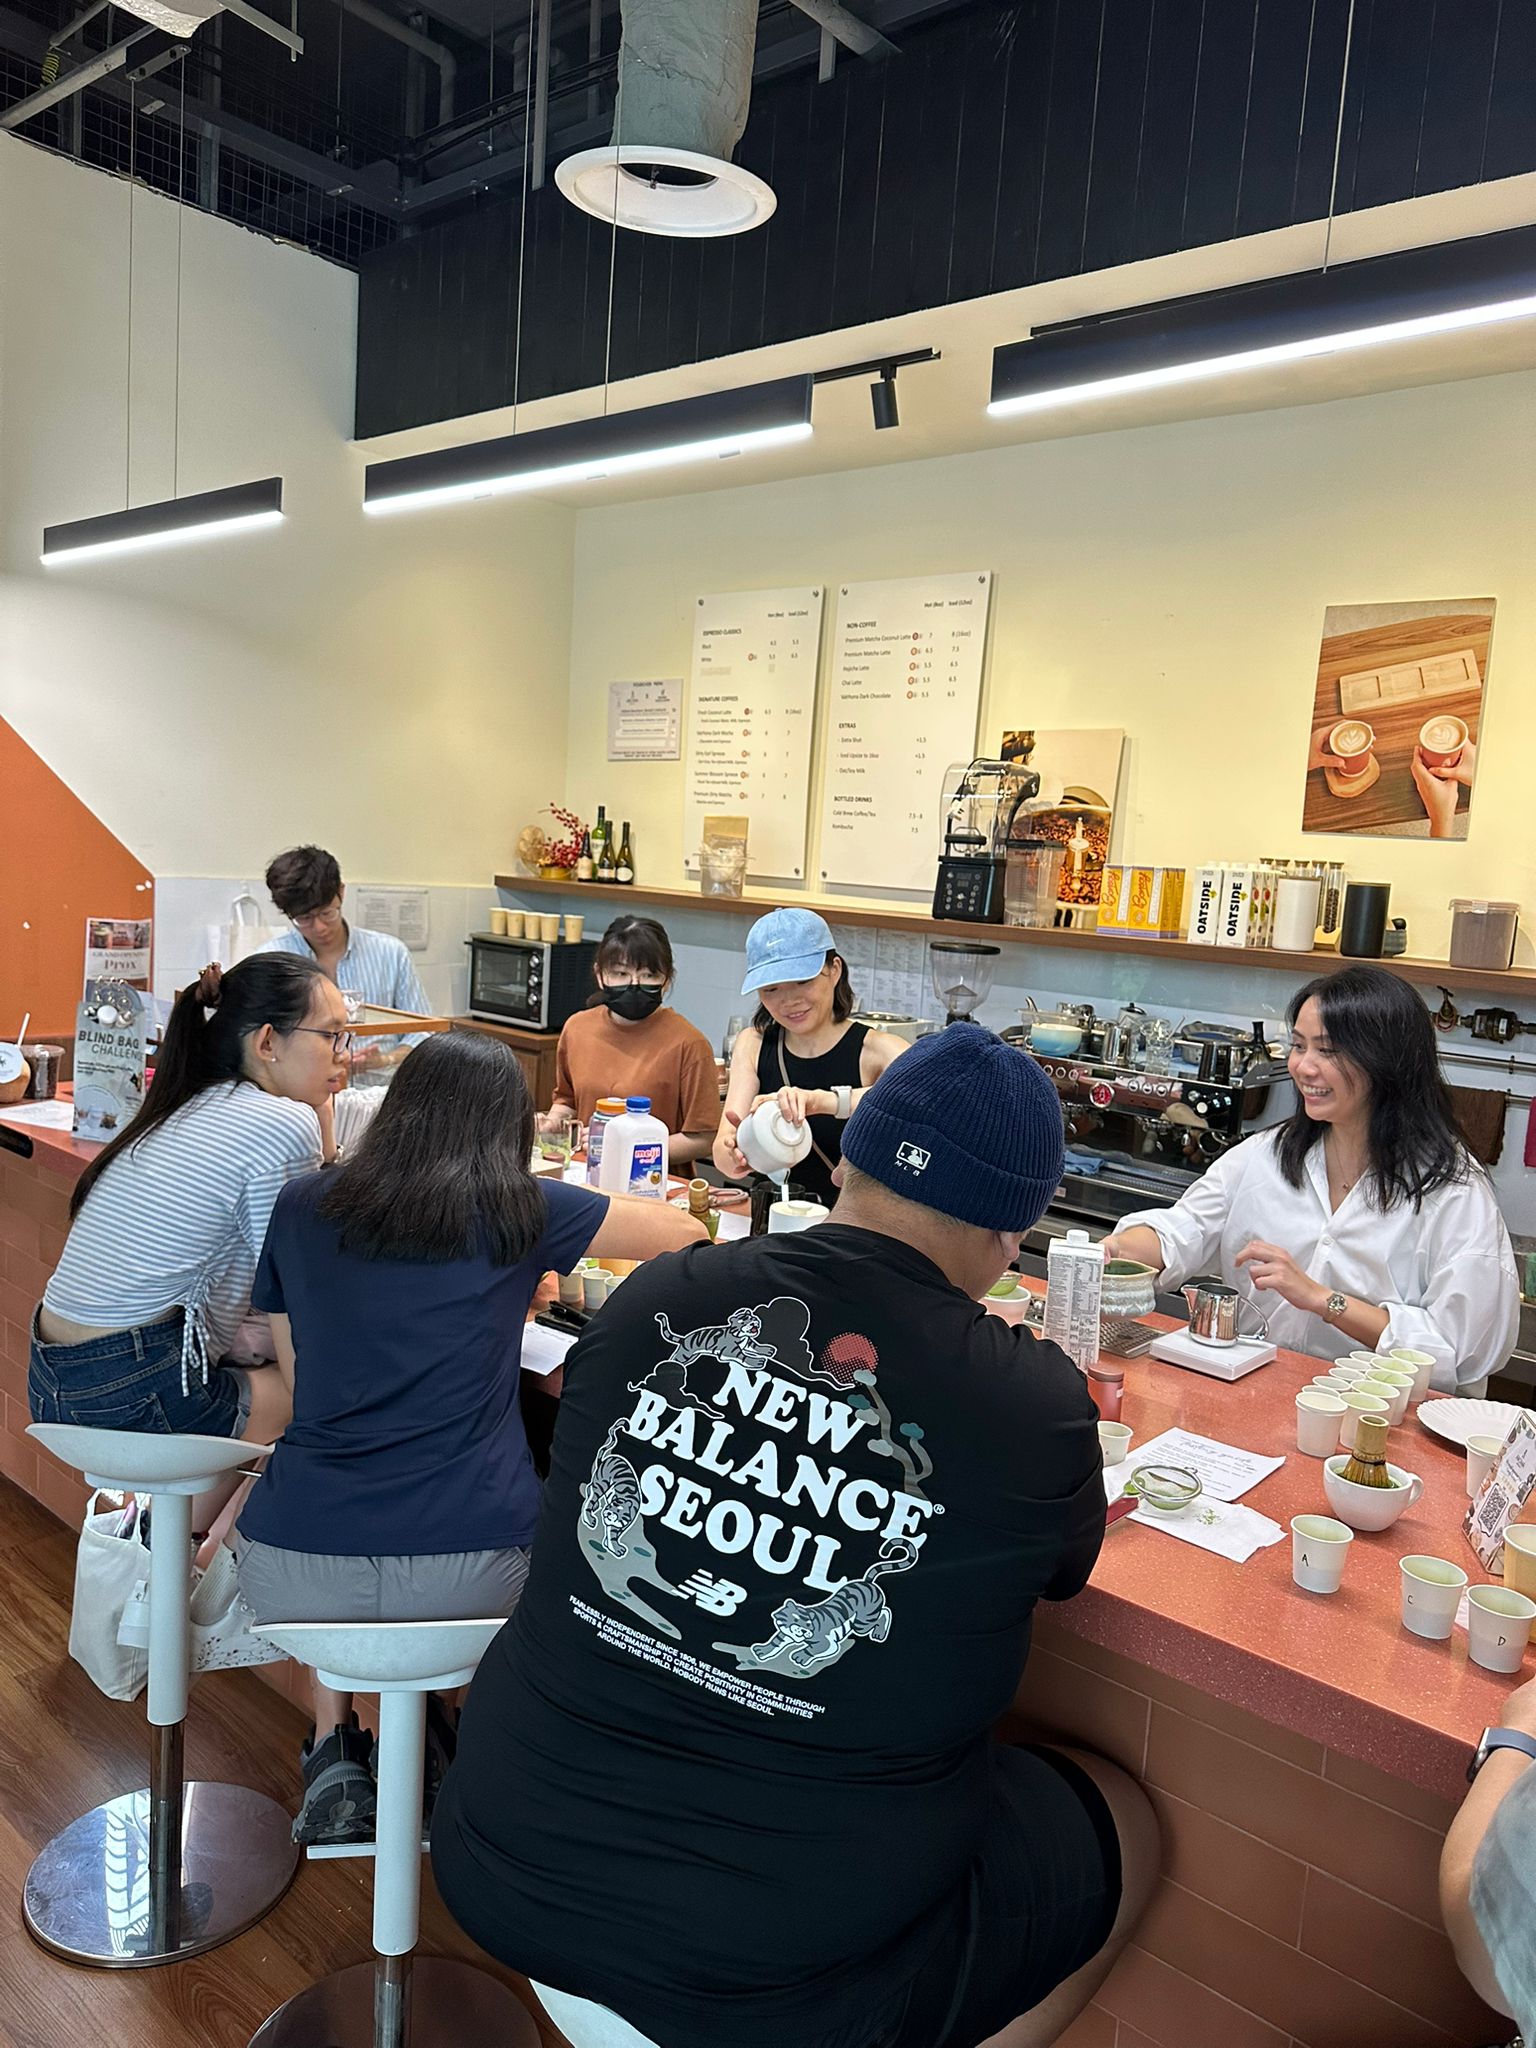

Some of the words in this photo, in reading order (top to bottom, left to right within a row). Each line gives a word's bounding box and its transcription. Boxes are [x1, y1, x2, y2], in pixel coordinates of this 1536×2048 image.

[1197, 880, 1212, 934] OATSIDE
[1226, 882, 1242, 937] OATSIDE
[78, 1030, 114, 1045] BLIND
[117, 1035, 140, 1050] BAG
[635, 1146, 660, 1164] meiji
[894, 1160, 920, 1176] MLB
[712, 1360, 867, 1455] NEW
[625, 1389, 933, 1547] BALANCE
[638, 1464, 850, 1594] SEOUL
[1407, 1595, 1414, 1605] C
[569, 1595, 607, 1621] FEARLESSLY
[606, 1617, 657, 1646] INDEPENDENT
[656, 1641, 680, 1656] SINCE
[699, 1661, 711, 1673] WE
[712, 1667, 752, 1690] EMPOWER
[752, 1684, 784, 1702] PEOPLE
[785, 1696, 826, 1714] THROUGH
[573, 1607, 598, 1626] SPORTS
[596, 1622, 602, 1630] &
[602, 1625, 662, 1656] CRAFTSMANSHIP
[662, 1652, 674, 1663] TO
[674, 1658, 704, 1676] CREATE
[704, 1672, 746, 1696] POSITIVITY
[746, 1690, 756, 1700] IN
[756, 1694, 814, 1720] COMMUNITIES
[1497, 1636, 1506, 1646] D
[596, 1631, 627, 1650] AROUND
[628, 1644, 642, 1658] THE
[642, 1652, 672, 1671] WORLD.
[672, 1666, 706, 1686] NOBODY
[704, 1682, 728, 1698] RUNS
[728, 1692, 746, 1705] LIKE
[746, 1700, 774, 1716] SEOUL.
